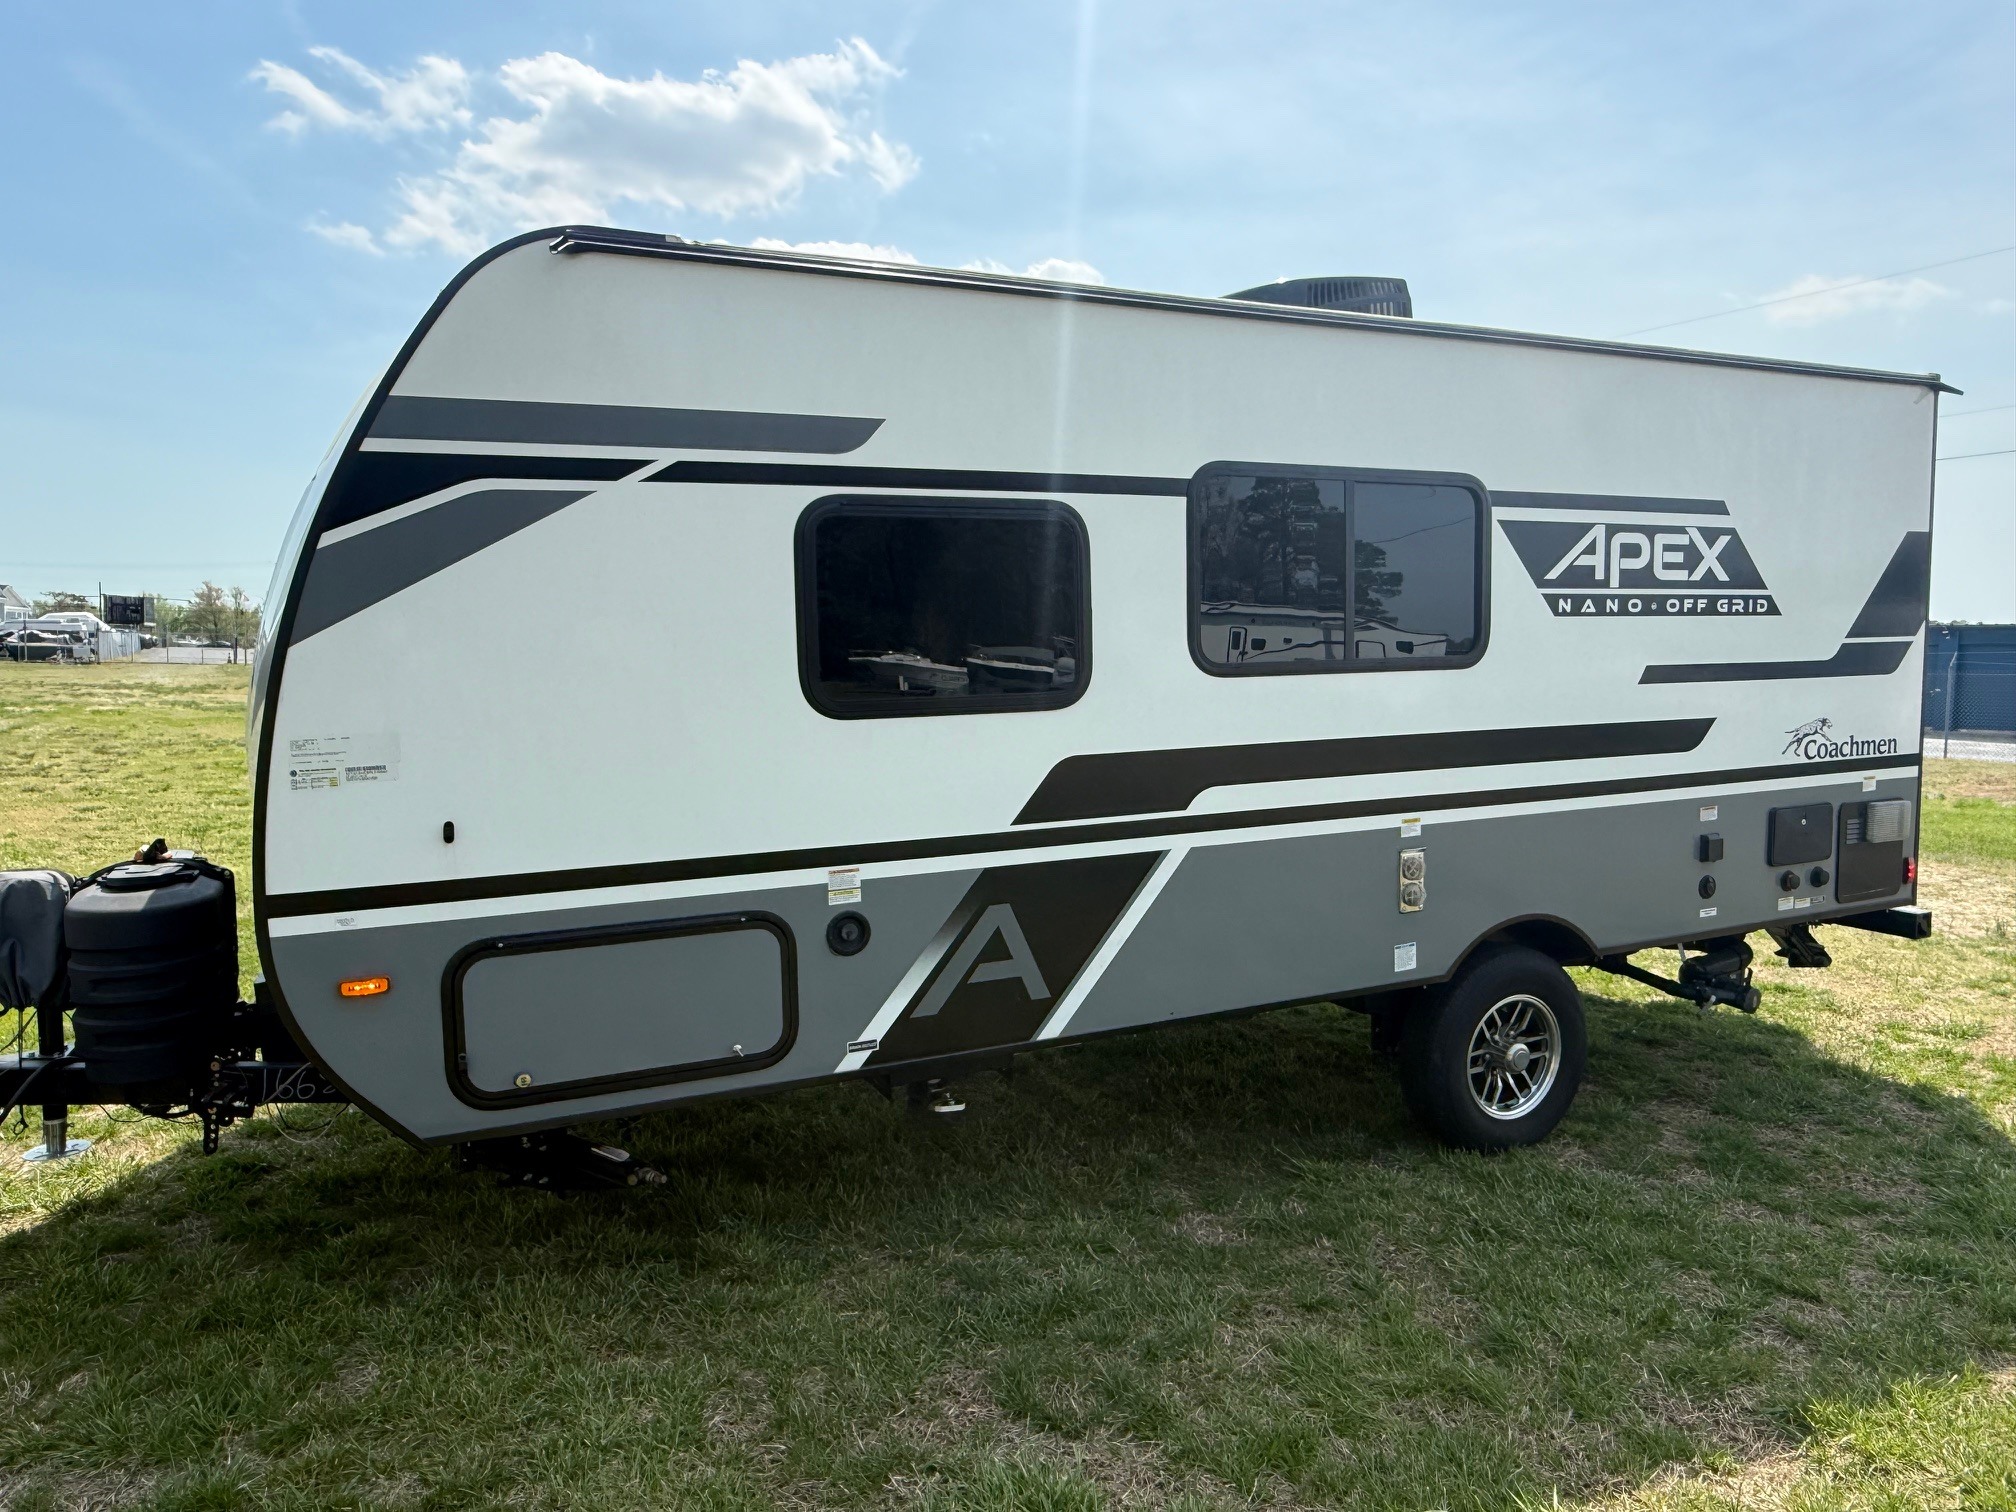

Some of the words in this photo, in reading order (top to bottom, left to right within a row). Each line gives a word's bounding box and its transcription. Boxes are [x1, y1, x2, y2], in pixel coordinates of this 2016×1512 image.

[1543, 524, 1732, 588] APEX
[1558, 598, 1643, 613] NANO
[1666, 598, 1708, 613] OFF
[1716, 598, 1768, 613] GRID
[1803, 735, 1898, 760] Coachmen
